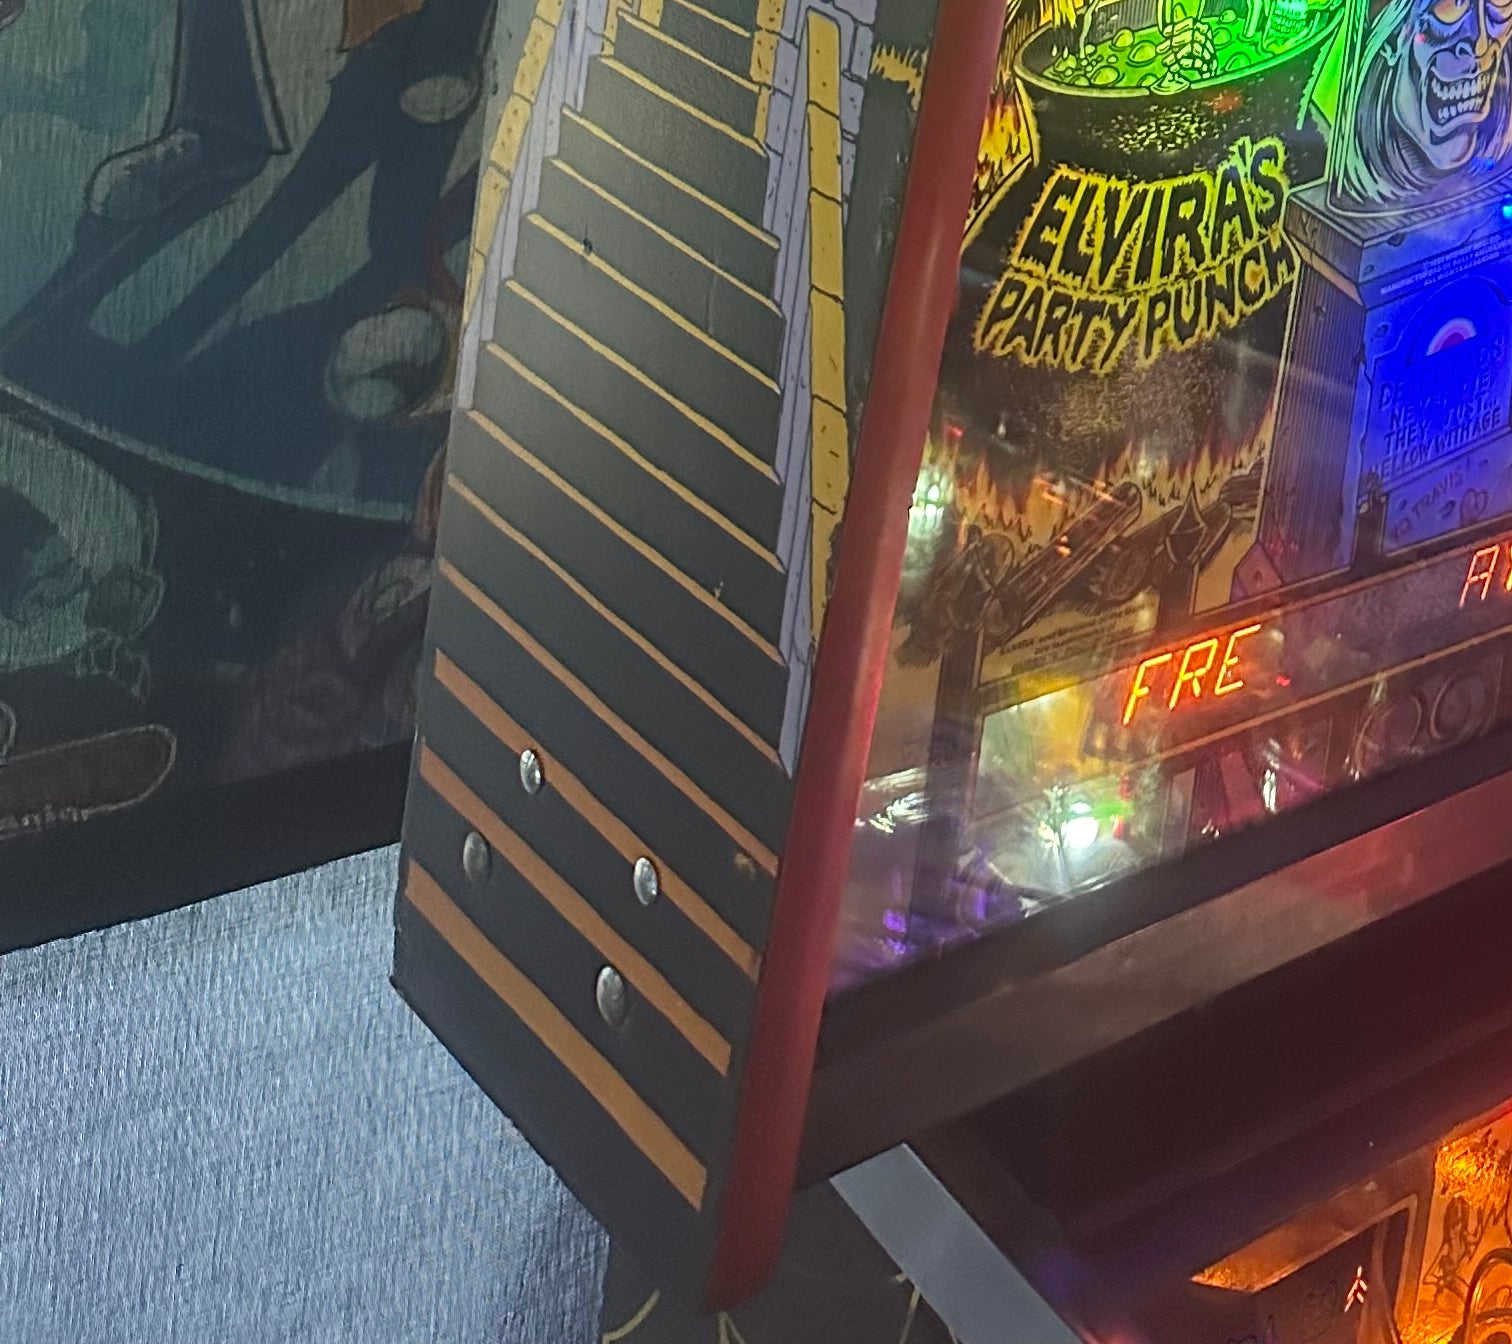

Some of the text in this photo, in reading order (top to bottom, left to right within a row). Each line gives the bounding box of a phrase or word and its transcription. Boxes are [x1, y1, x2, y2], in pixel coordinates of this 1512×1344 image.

[1014, 140, 1288, 288] ELVIRA'S
[975, 269, 1145, 373] PARTY
[1141, 234, 1298, 366] PUNCH
[1121, 623, 1262, 727] FRE
